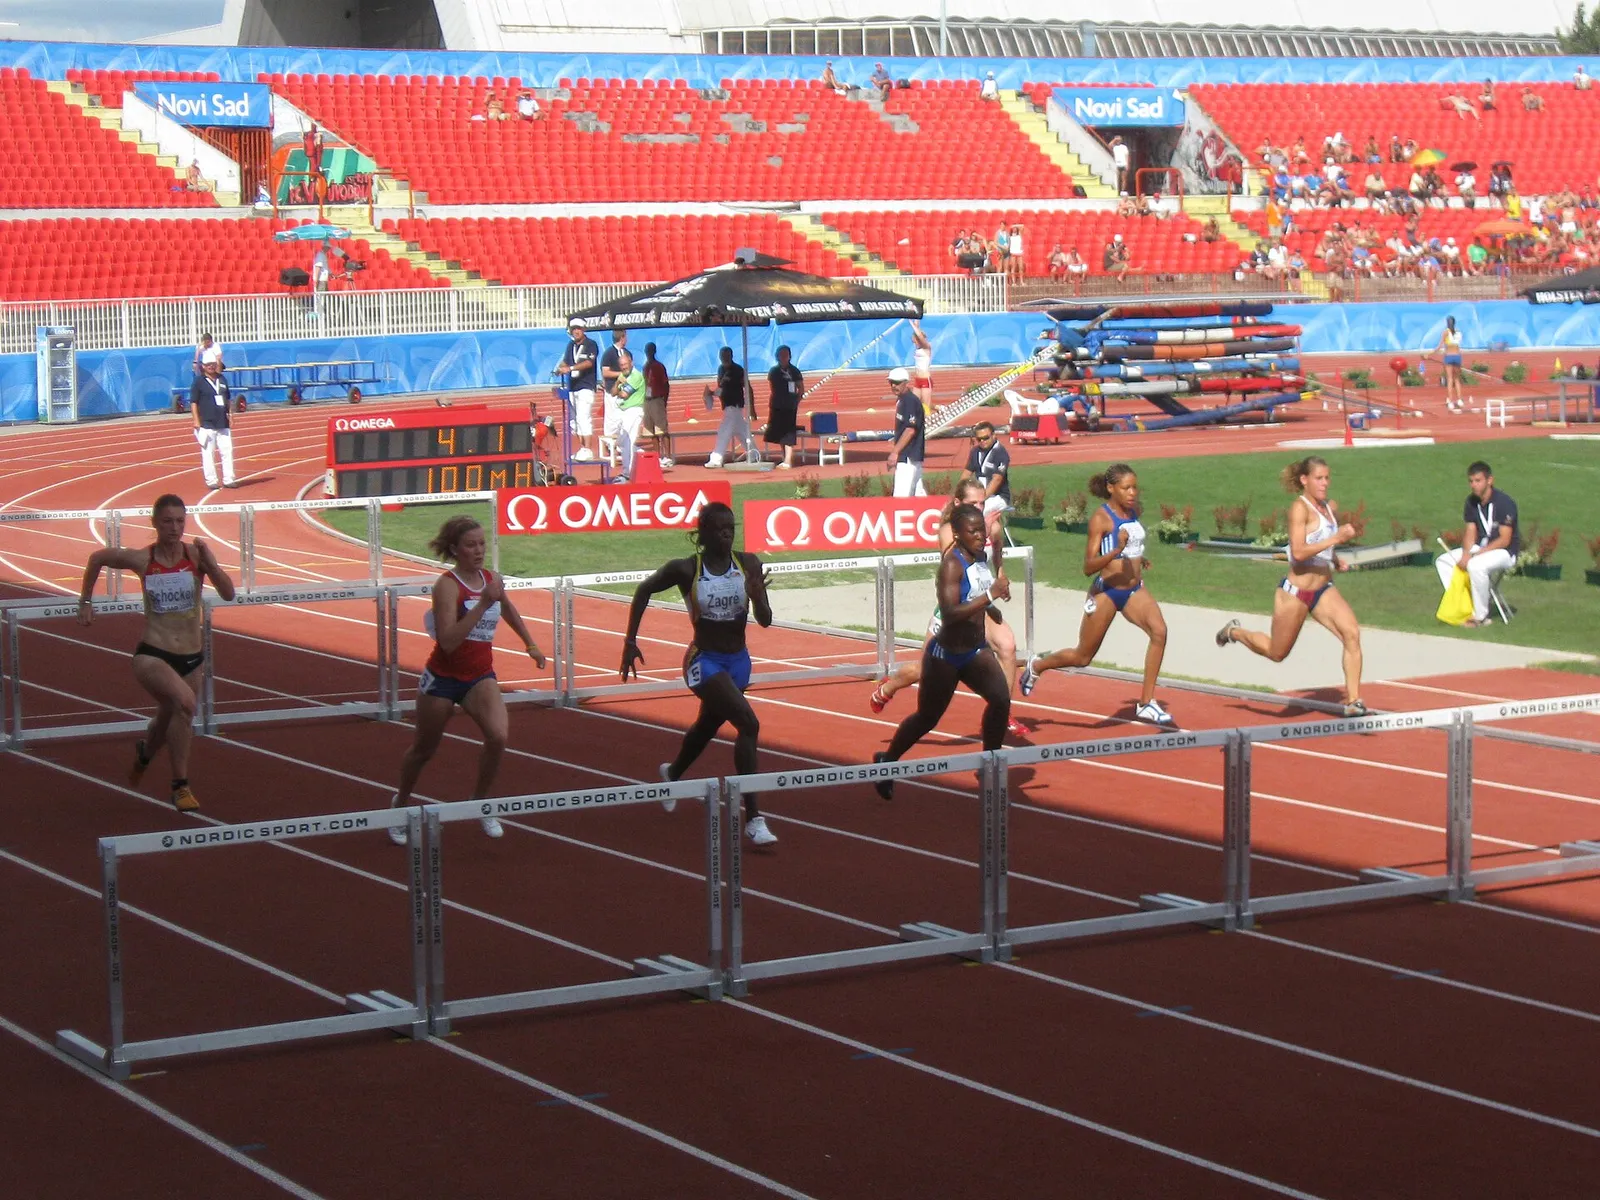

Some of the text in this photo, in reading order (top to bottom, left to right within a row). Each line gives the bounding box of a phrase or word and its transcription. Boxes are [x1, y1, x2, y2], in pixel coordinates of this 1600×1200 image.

[157, 91, 249, 117] Novi Sad
[1074, 95, 1164, 118] Novi Sad
[1535, 290, 1584, 303] HOLSTEN
[614, 312, 646, 325] HOLSTEN
[792, 302, 838, 313] HOLSTEN
[858, 301, 905, 312] HOLSTEN
[350, 417, 395, 430] OMEGA
[559, 489, 710, 529] OMEGA
[822, 509, 943, 547] OMEG
[707, 589, 740, 610] Zagré
[691, 665, 700, 682] 5
